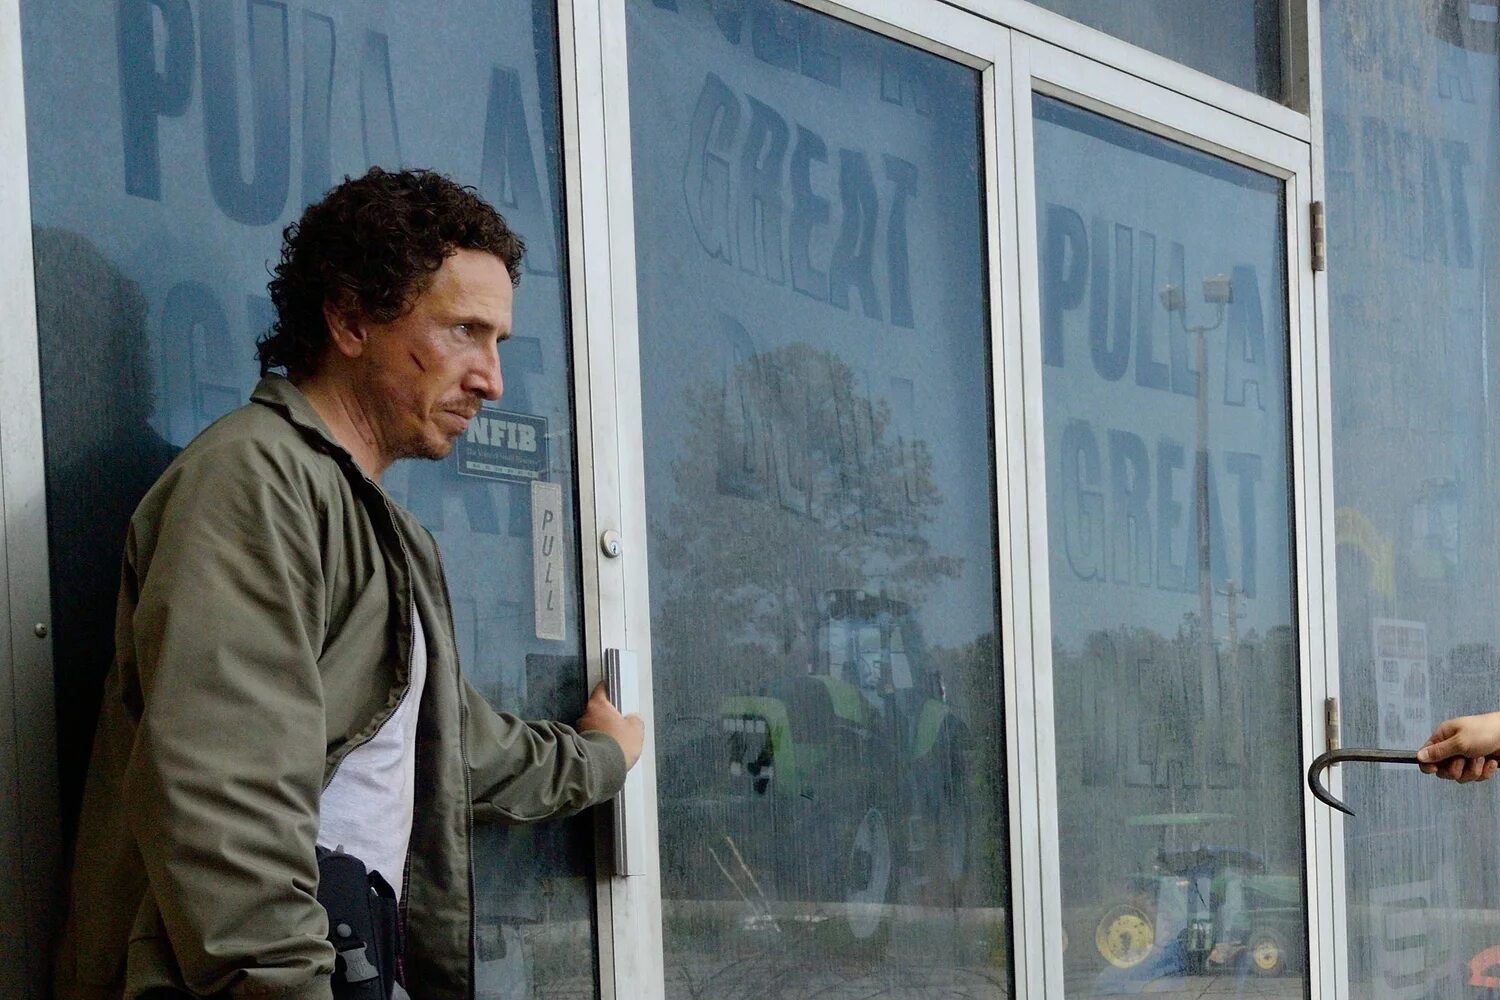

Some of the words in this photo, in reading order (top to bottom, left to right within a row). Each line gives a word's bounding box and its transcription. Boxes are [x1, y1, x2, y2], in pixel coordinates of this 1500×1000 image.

[684, 71, 919, 329] GREAT
[1043, 202, 1200, 398] PULL
[1222, 263, 1267, 411] A
[466, 416, 537, 453] NFIB
[1060, 418, 1265, 600] GREAT
[541, 508, 555, 612] PULL
